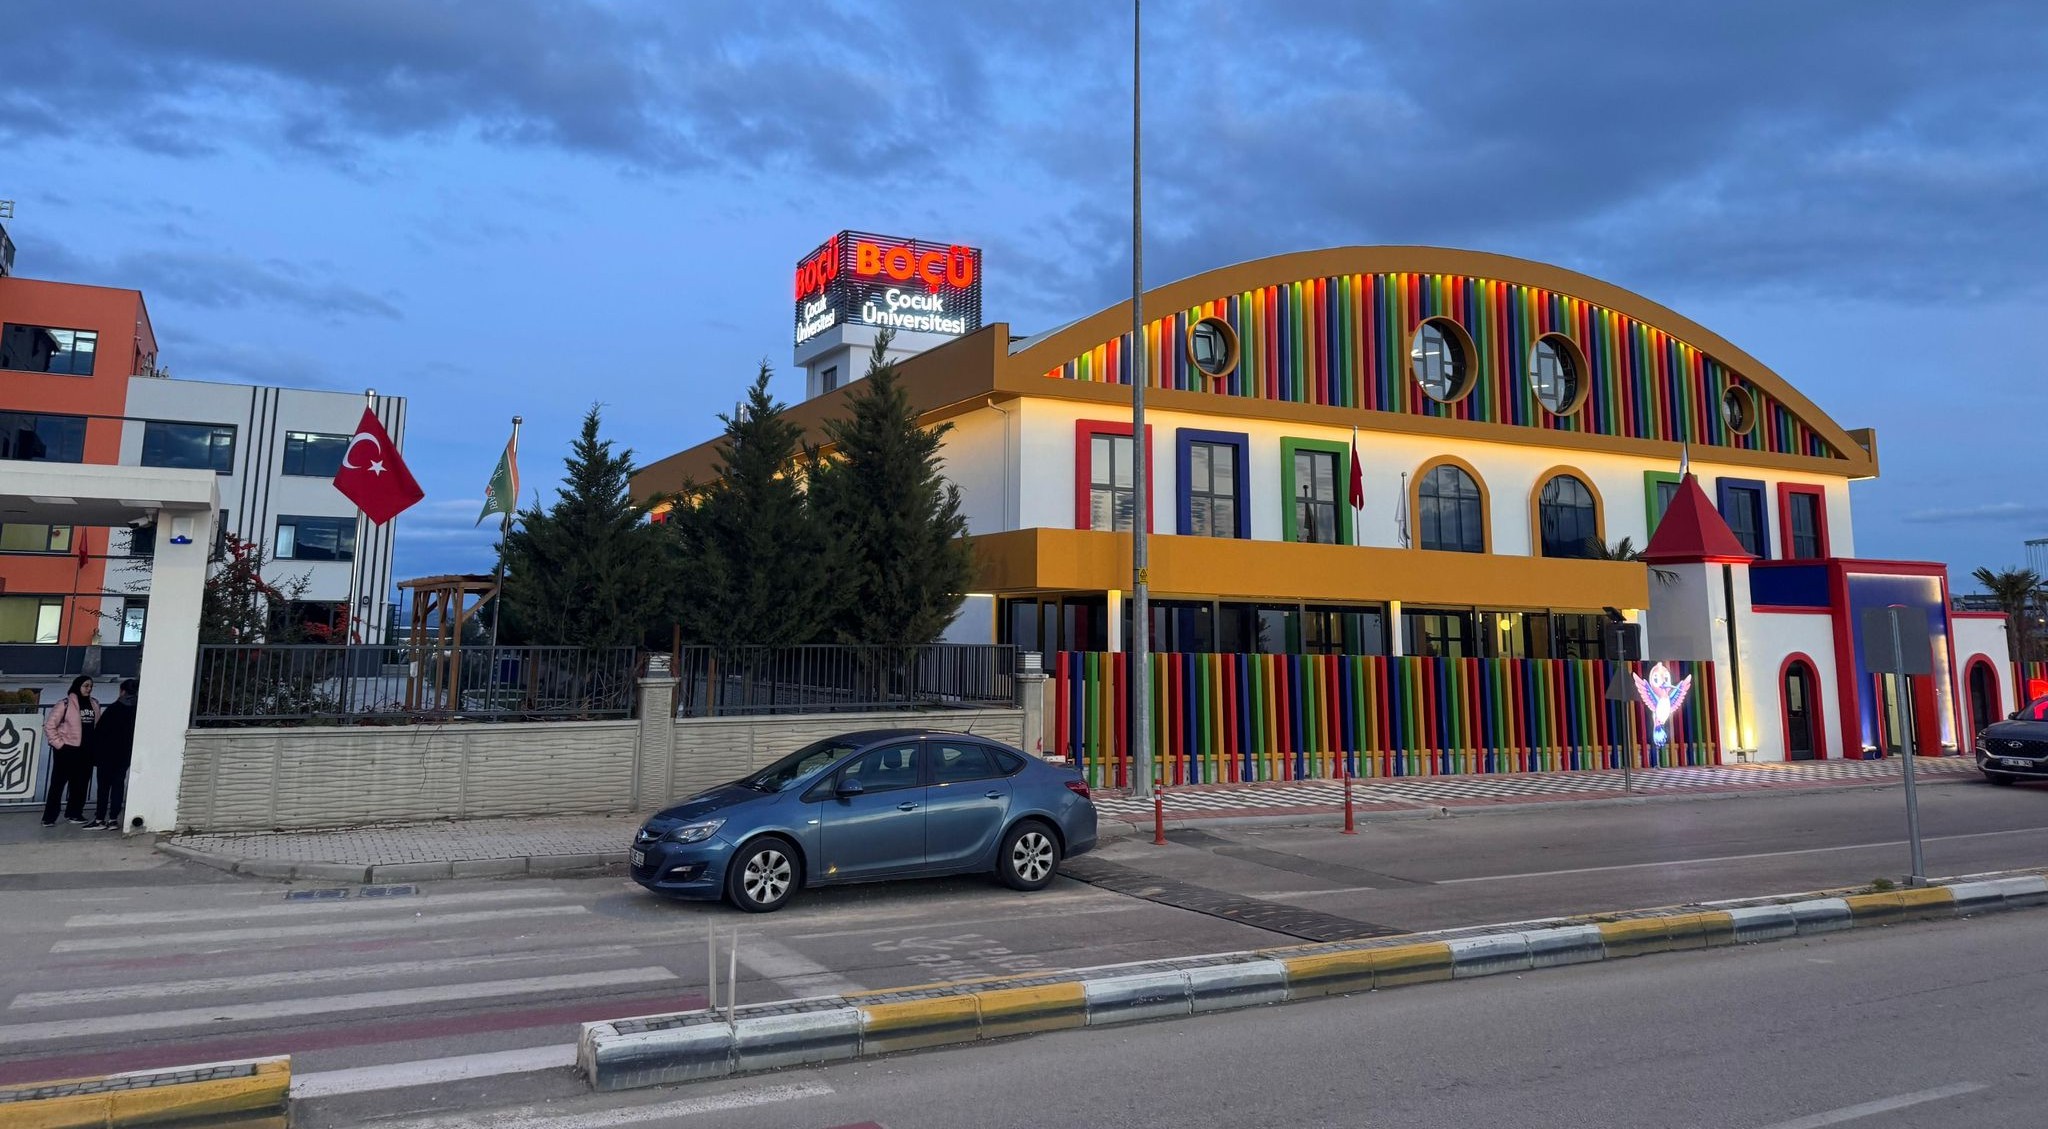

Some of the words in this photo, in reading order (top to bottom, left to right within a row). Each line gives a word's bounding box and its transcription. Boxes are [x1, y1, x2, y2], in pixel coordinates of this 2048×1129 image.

[795, 235, 838, 301] BOÇÜ
[855, 241, 973, 294] BOÇÜ
[804, 294, 827, 321] Çocuk
[884, 288, 943, 313] Çocuk
[862, 302, 966, 334] Üniversitesi
